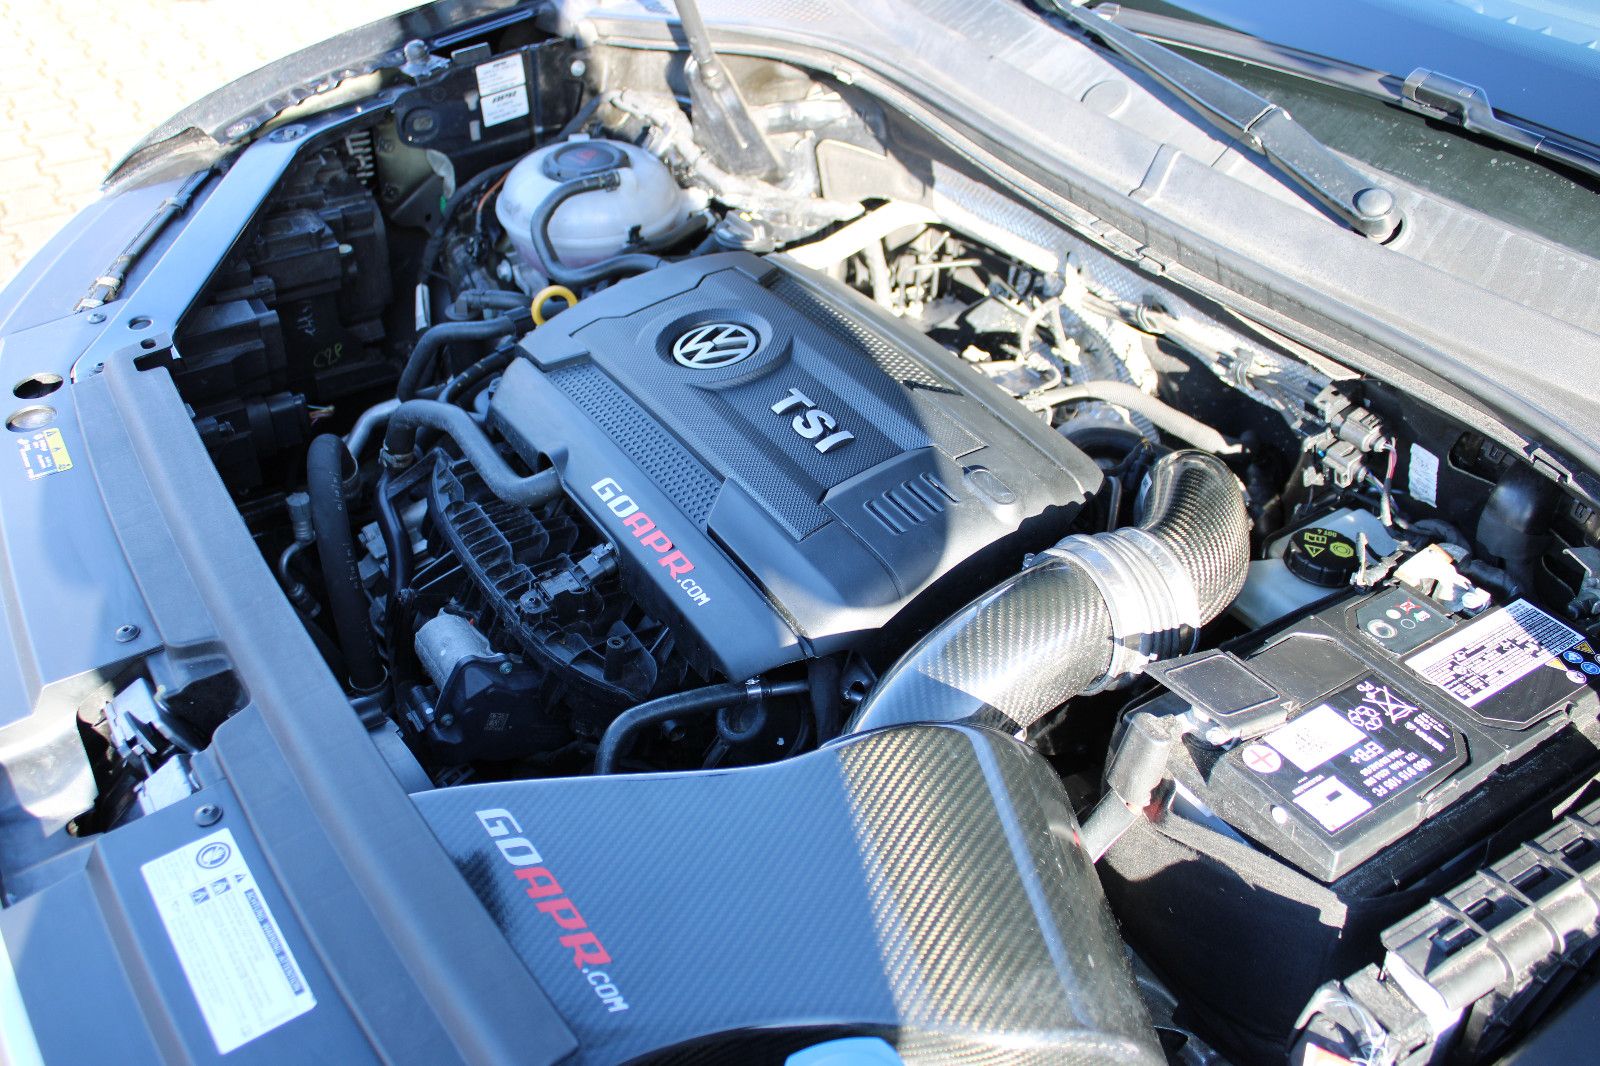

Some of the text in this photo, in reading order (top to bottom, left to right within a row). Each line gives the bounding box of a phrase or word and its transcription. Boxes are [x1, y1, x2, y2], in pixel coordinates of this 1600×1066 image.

[771, 387, 855, 454] TSI
[1349, 741, 1385, 764] EFB+
[1371, 785, 1389, 797] FC
